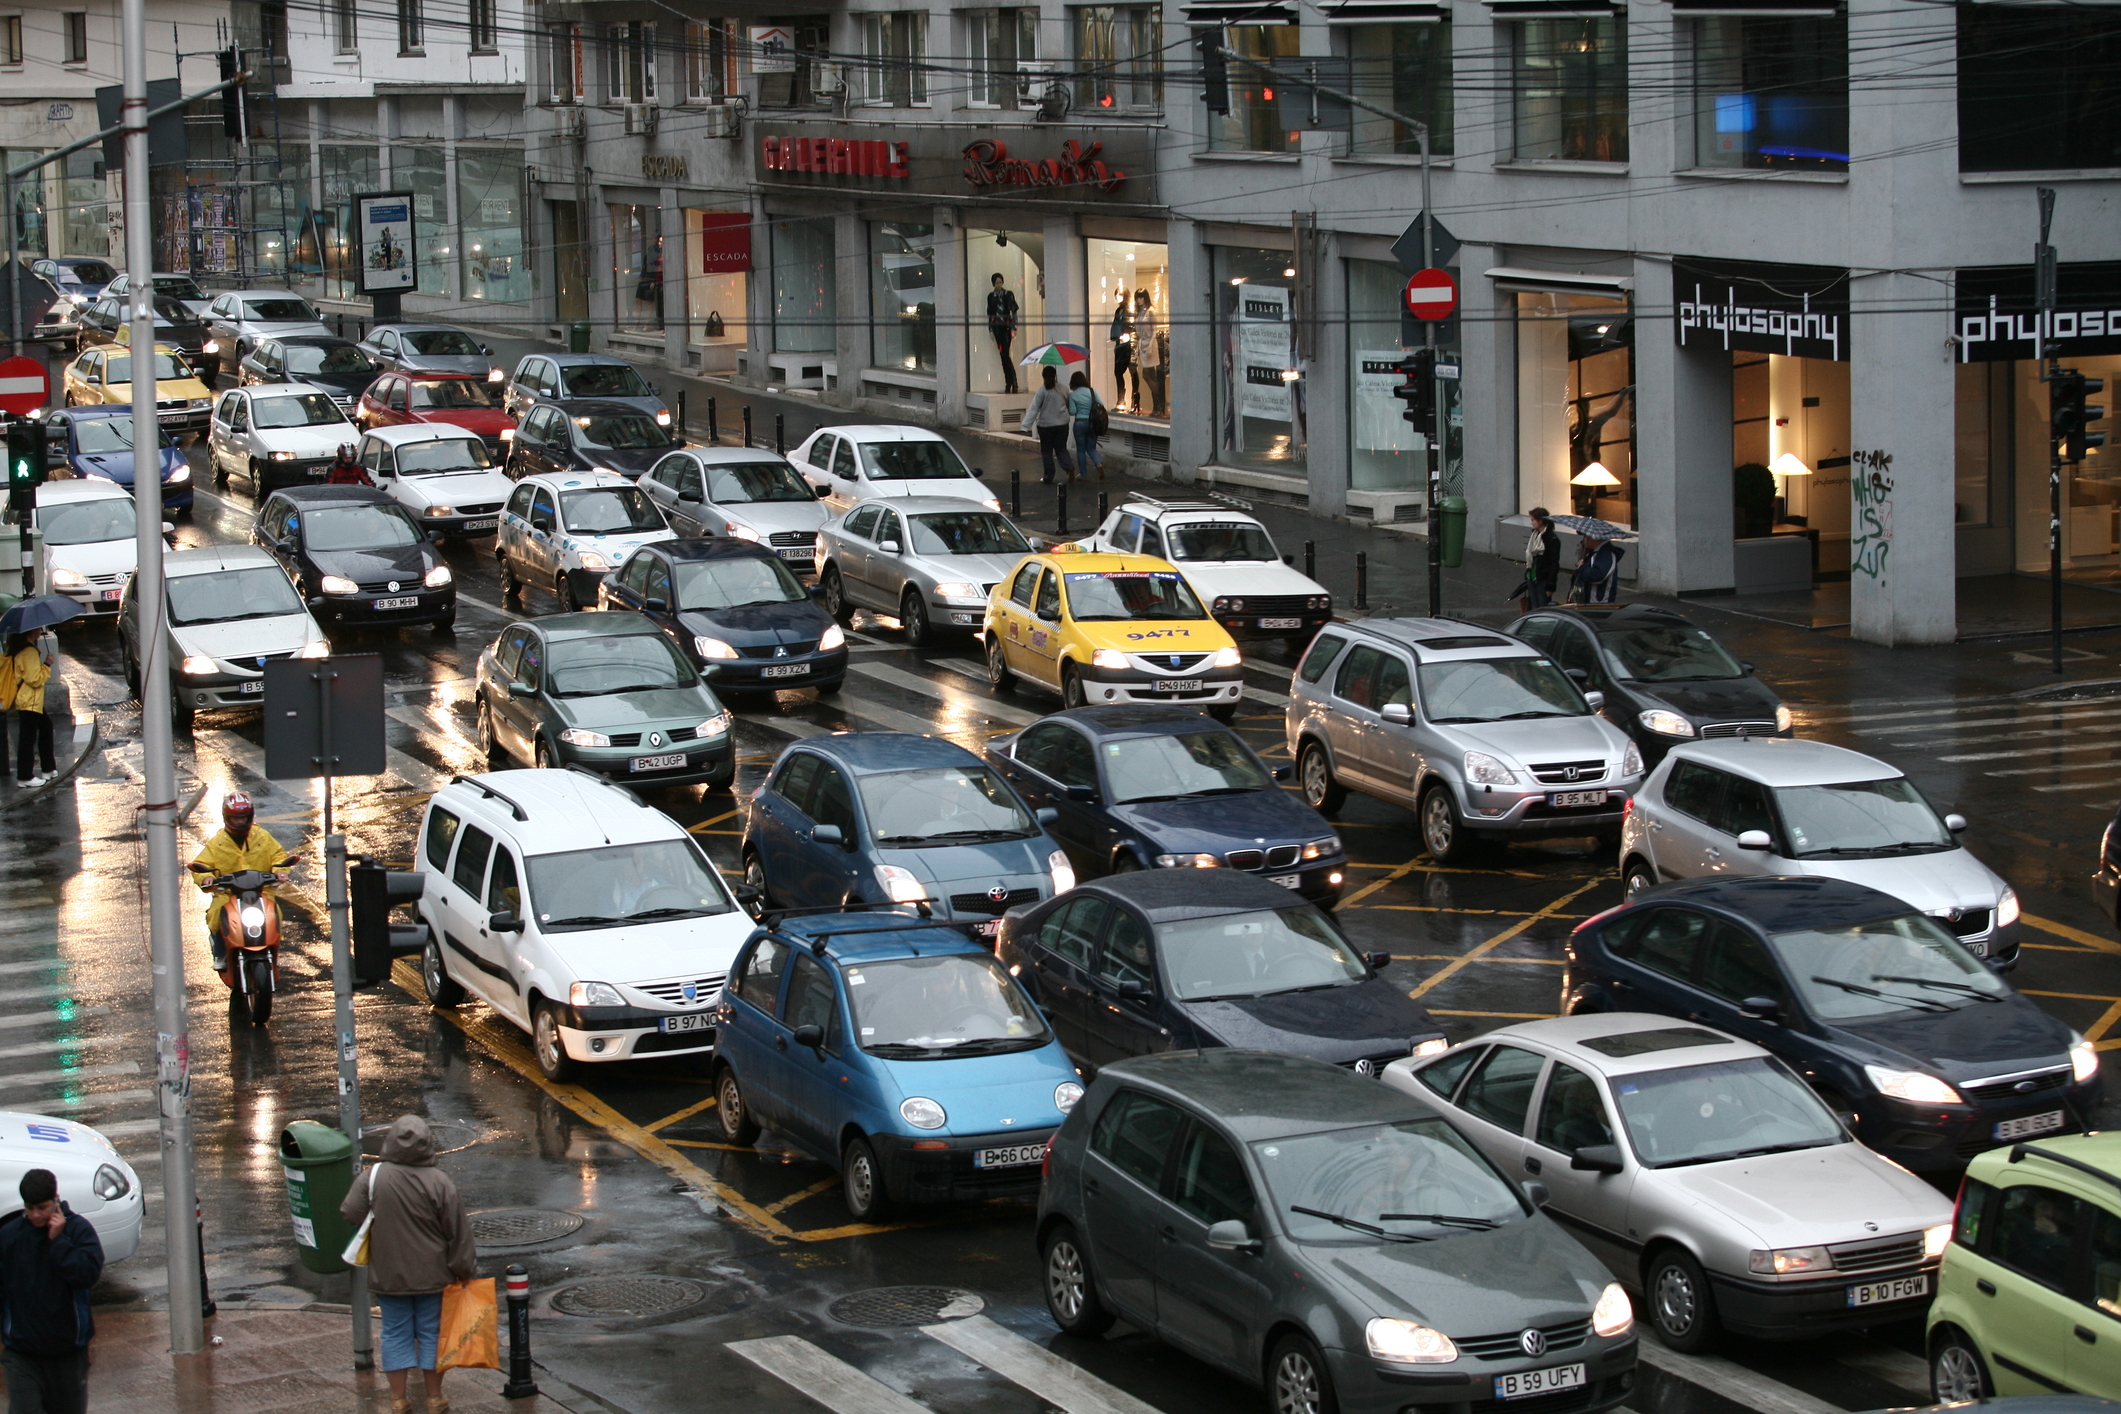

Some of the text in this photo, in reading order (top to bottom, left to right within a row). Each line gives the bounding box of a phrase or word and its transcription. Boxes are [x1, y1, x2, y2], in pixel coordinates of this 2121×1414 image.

[642, 155, 687, 177] ESCADA
[706, 252, 748, 262] ESCADA
[1249, 303, 1280, 313] SISLEY
[1680, 283, 1838, 362] phylosophy
[1251, 369, 1282, 379] SISLEY
[1065, 544, 1077, 552] TAXI
[781, 550, 787, 558] B
[106, 592, 112, 600] B
[378, 598, 416, 608] B 90 MHH
[1126, 629, 1190, 640] 9477
[767, 664, 807, 676] B 99 XZK
[246, 683, 253, 691] B
[1159, 680, 1198, 690] B 49 HXF
[638, 755, 683, 769] B 42 UGP
[1556, 792, 1602, 804] B 95 MLT
[668, 1018, 677, 1030] B
[682, 1016, 697, 1028] 97
[2002, 1123, 2011, 1136] B
[985, 1150, 995, 1164] B
[1000, 1148, 1017, 1163] 66
[1860, 1277, 1923, 1303] B 10 FGW
[1505, 1376, 1517, 1394] B
[1523, 1372, 1541, 1390] 59
[1548, 1365, 1580, 1386] UFY
